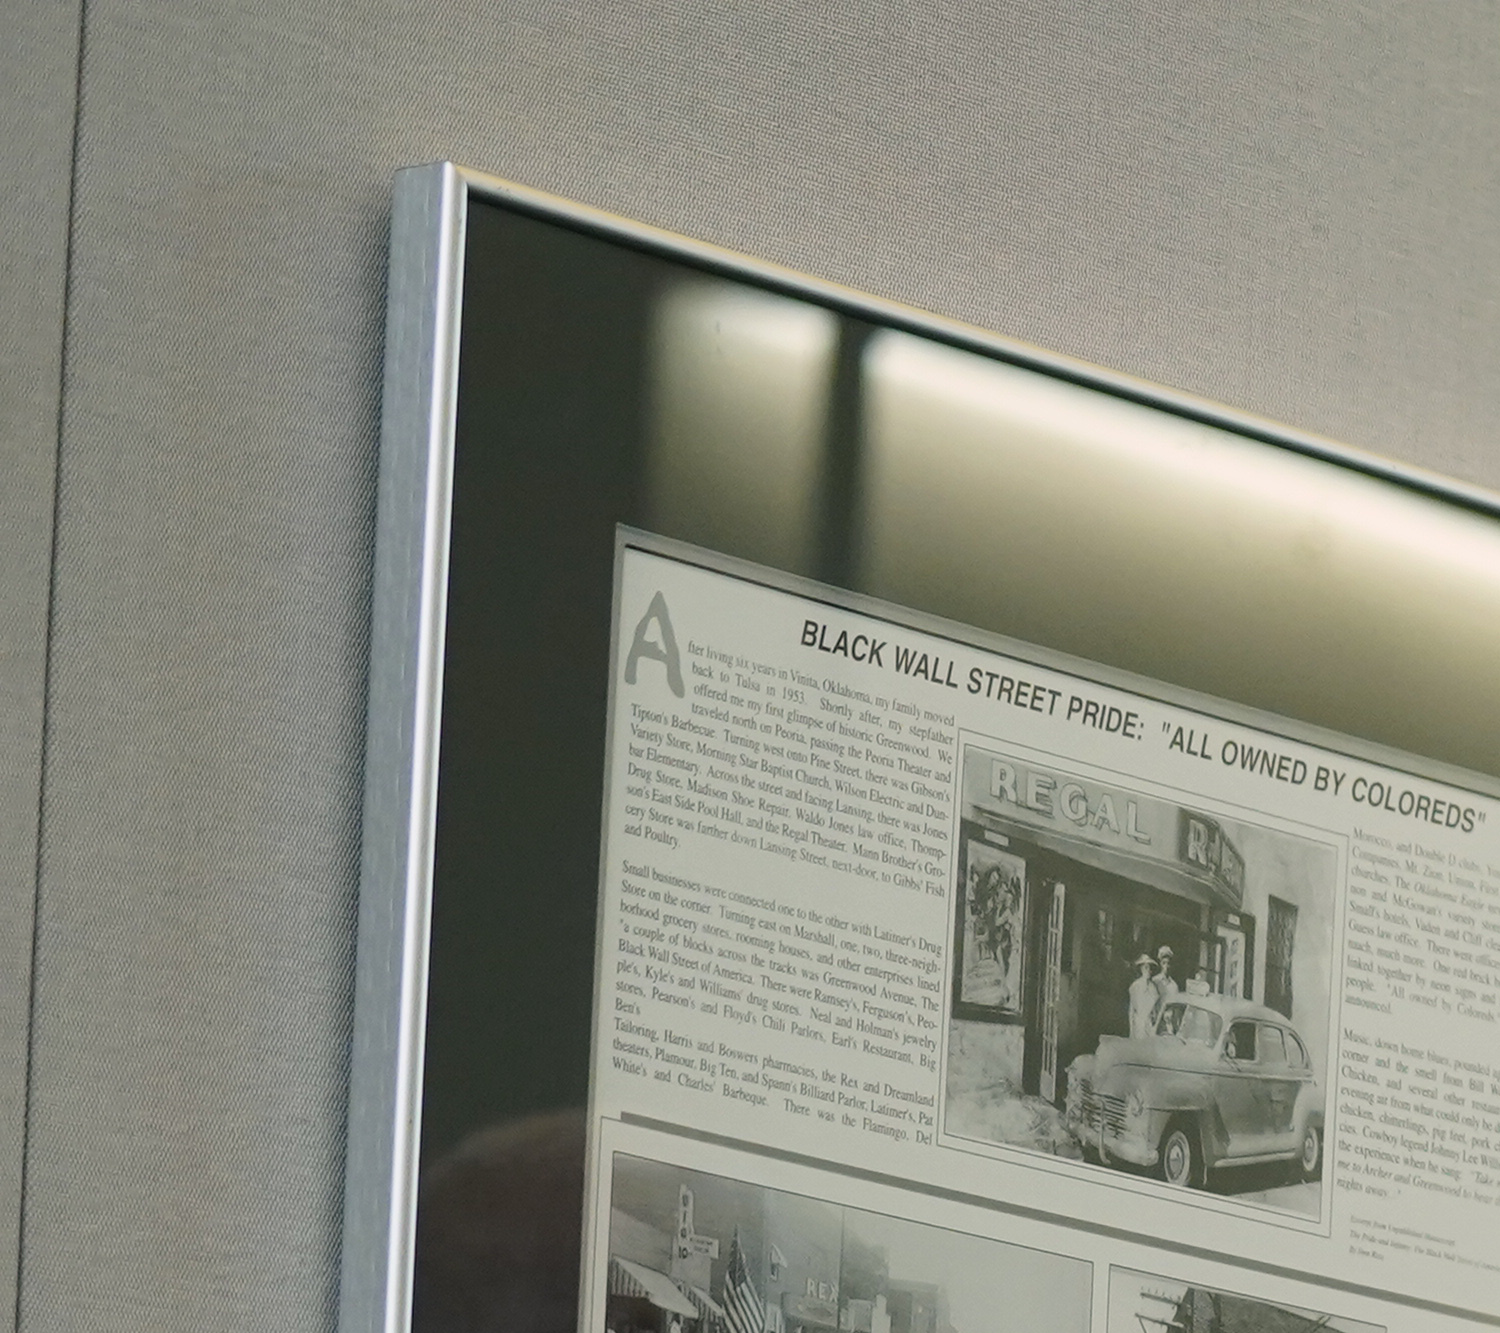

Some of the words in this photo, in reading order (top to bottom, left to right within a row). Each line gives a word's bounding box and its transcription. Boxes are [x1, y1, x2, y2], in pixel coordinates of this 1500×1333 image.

[624, 590, 685, 699] A
[800, 619, 887, 668] BLACK
[892, 645, 960, 689] WALL
[966, 666, 1062, 717] STREET
[1066, 694, 1145, 740] PRIDE:
[1220, 738, 1308, 786] OWNED
[1313, 764, 1346, 797] BY
[990, 759, 1151, 845] REGAL
[807, 1277, 839, 1304] REX
